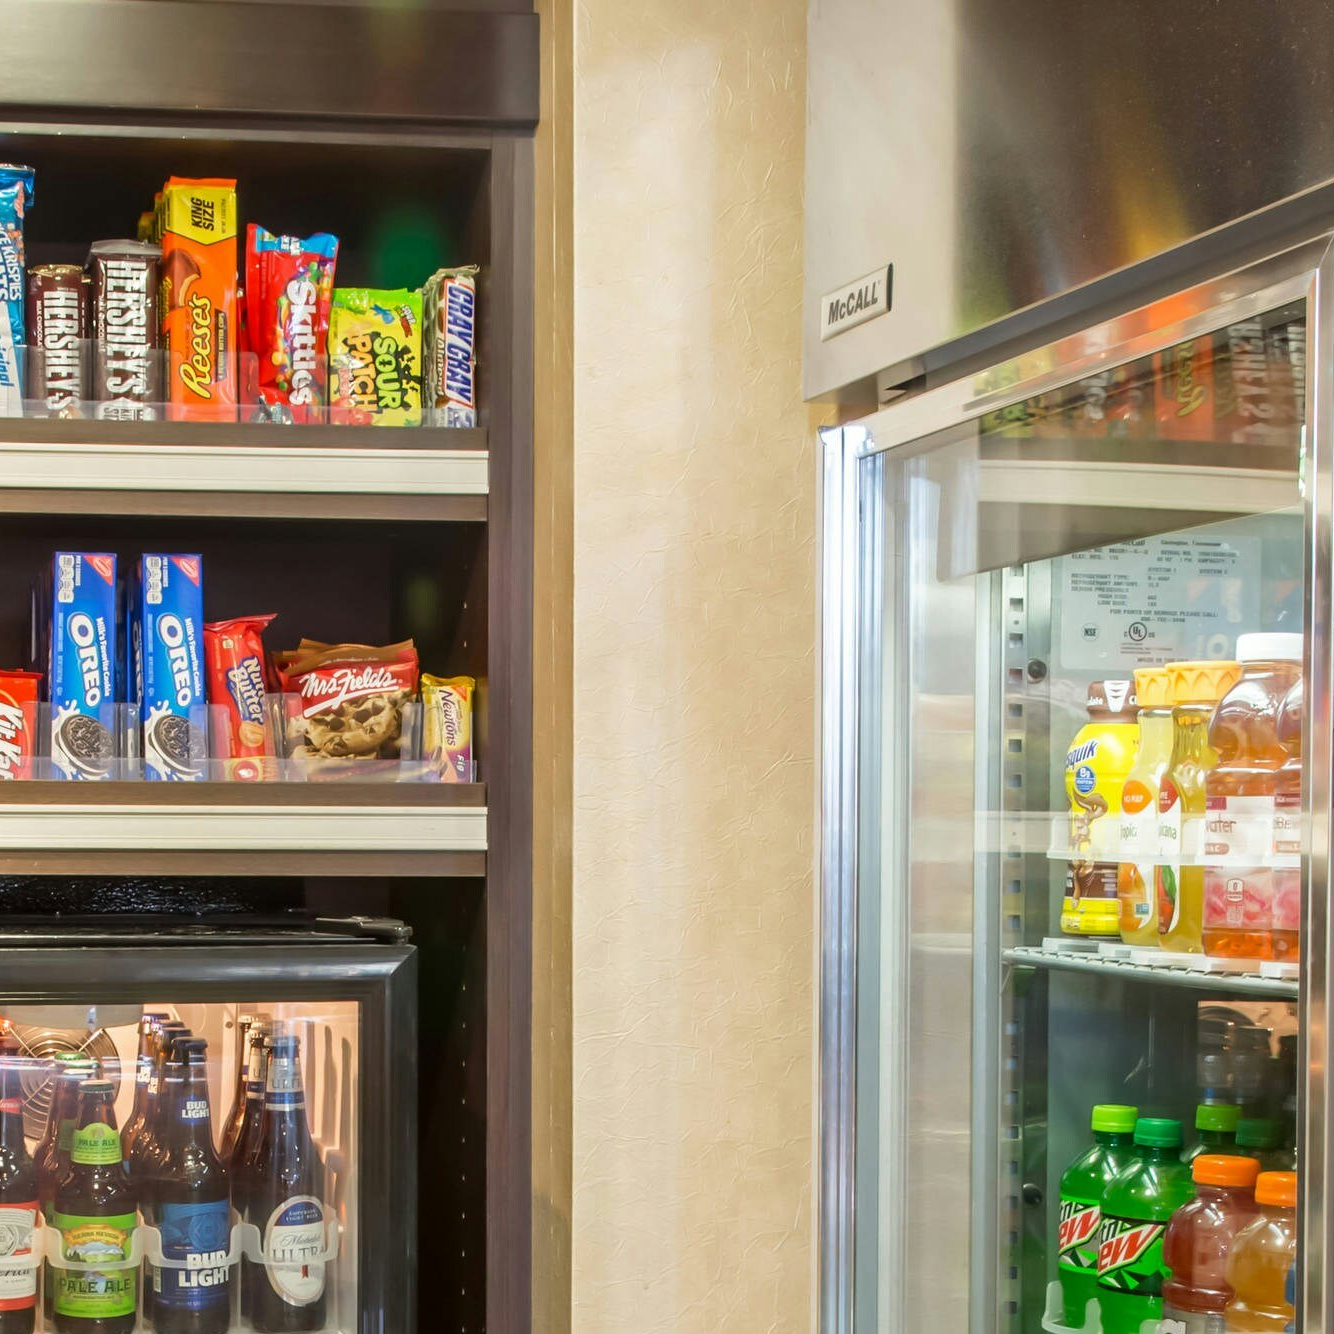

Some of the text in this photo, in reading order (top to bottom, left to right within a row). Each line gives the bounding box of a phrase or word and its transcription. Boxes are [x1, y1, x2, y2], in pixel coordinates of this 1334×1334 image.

[192, 196, 203, 230] KING
[203, 199, 214, 232] SIZE
[828, 280, 882, 327] McCALL
[106, 260, 151, 394] HERSHEY'S
[179, 292, 212, 399] Reese's
[43, 289, 81, 416] HERSHEY'S
[372, 336, 403, 410] SOUR
[70, 612, 101, 707] OREO
[158, 613, 192, 707] OREO
[438, 689, 457, 747] Newtons
[456, 754, 465, 772] Fig
[181, 1108, 209, 1119] LIGHT
[186, 1100, 208, 1110] BUD
[178, 1266, 229, 1287] LIGHT
[187, 1250, 227, 1270] BUD
[58, 1277, 132, 1294] PALE ALE
